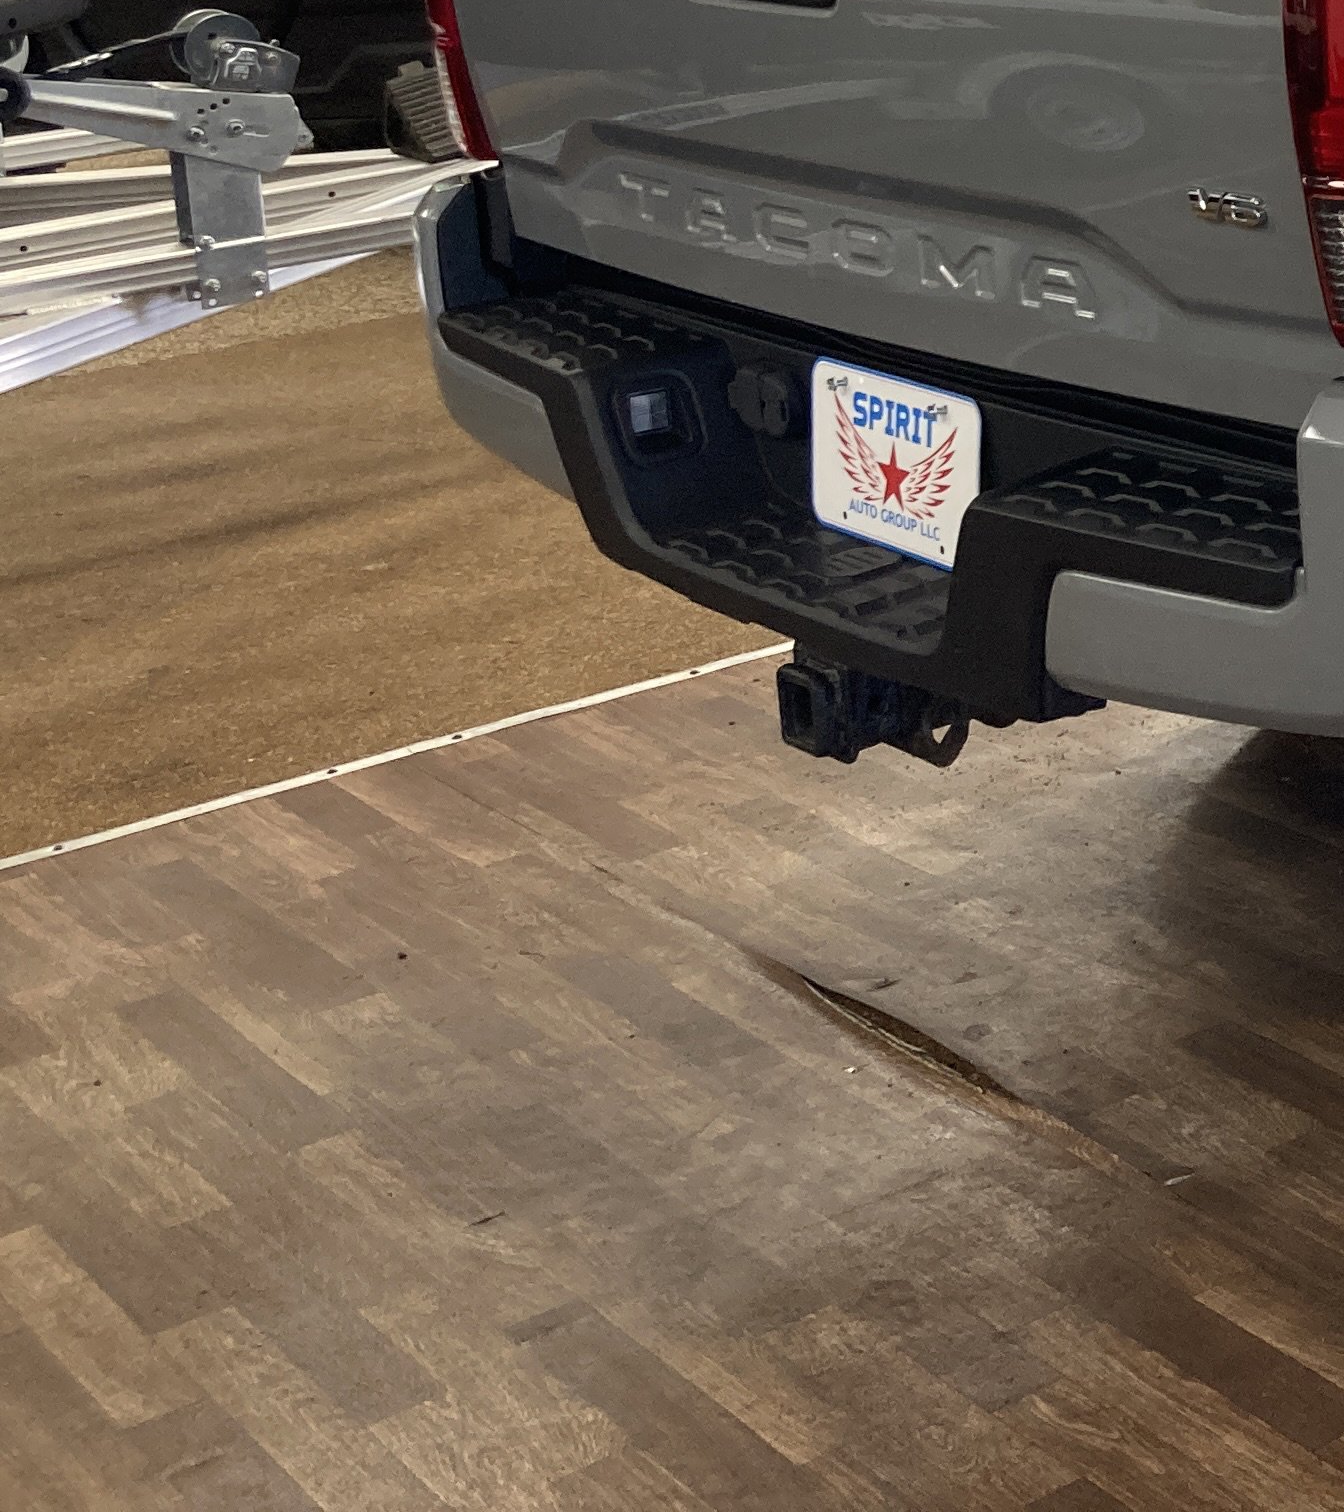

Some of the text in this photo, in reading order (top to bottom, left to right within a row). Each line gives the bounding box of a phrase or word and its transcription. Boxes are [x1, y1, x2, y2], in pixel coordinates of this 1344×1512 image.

[1186, 187, 1269, 228] V6
[618, 171, 1097, 320] TACOMA
[852, 391, 938, 448] SPIRIT
[849, 499, 941, 542] AUTO GROUP LLC
